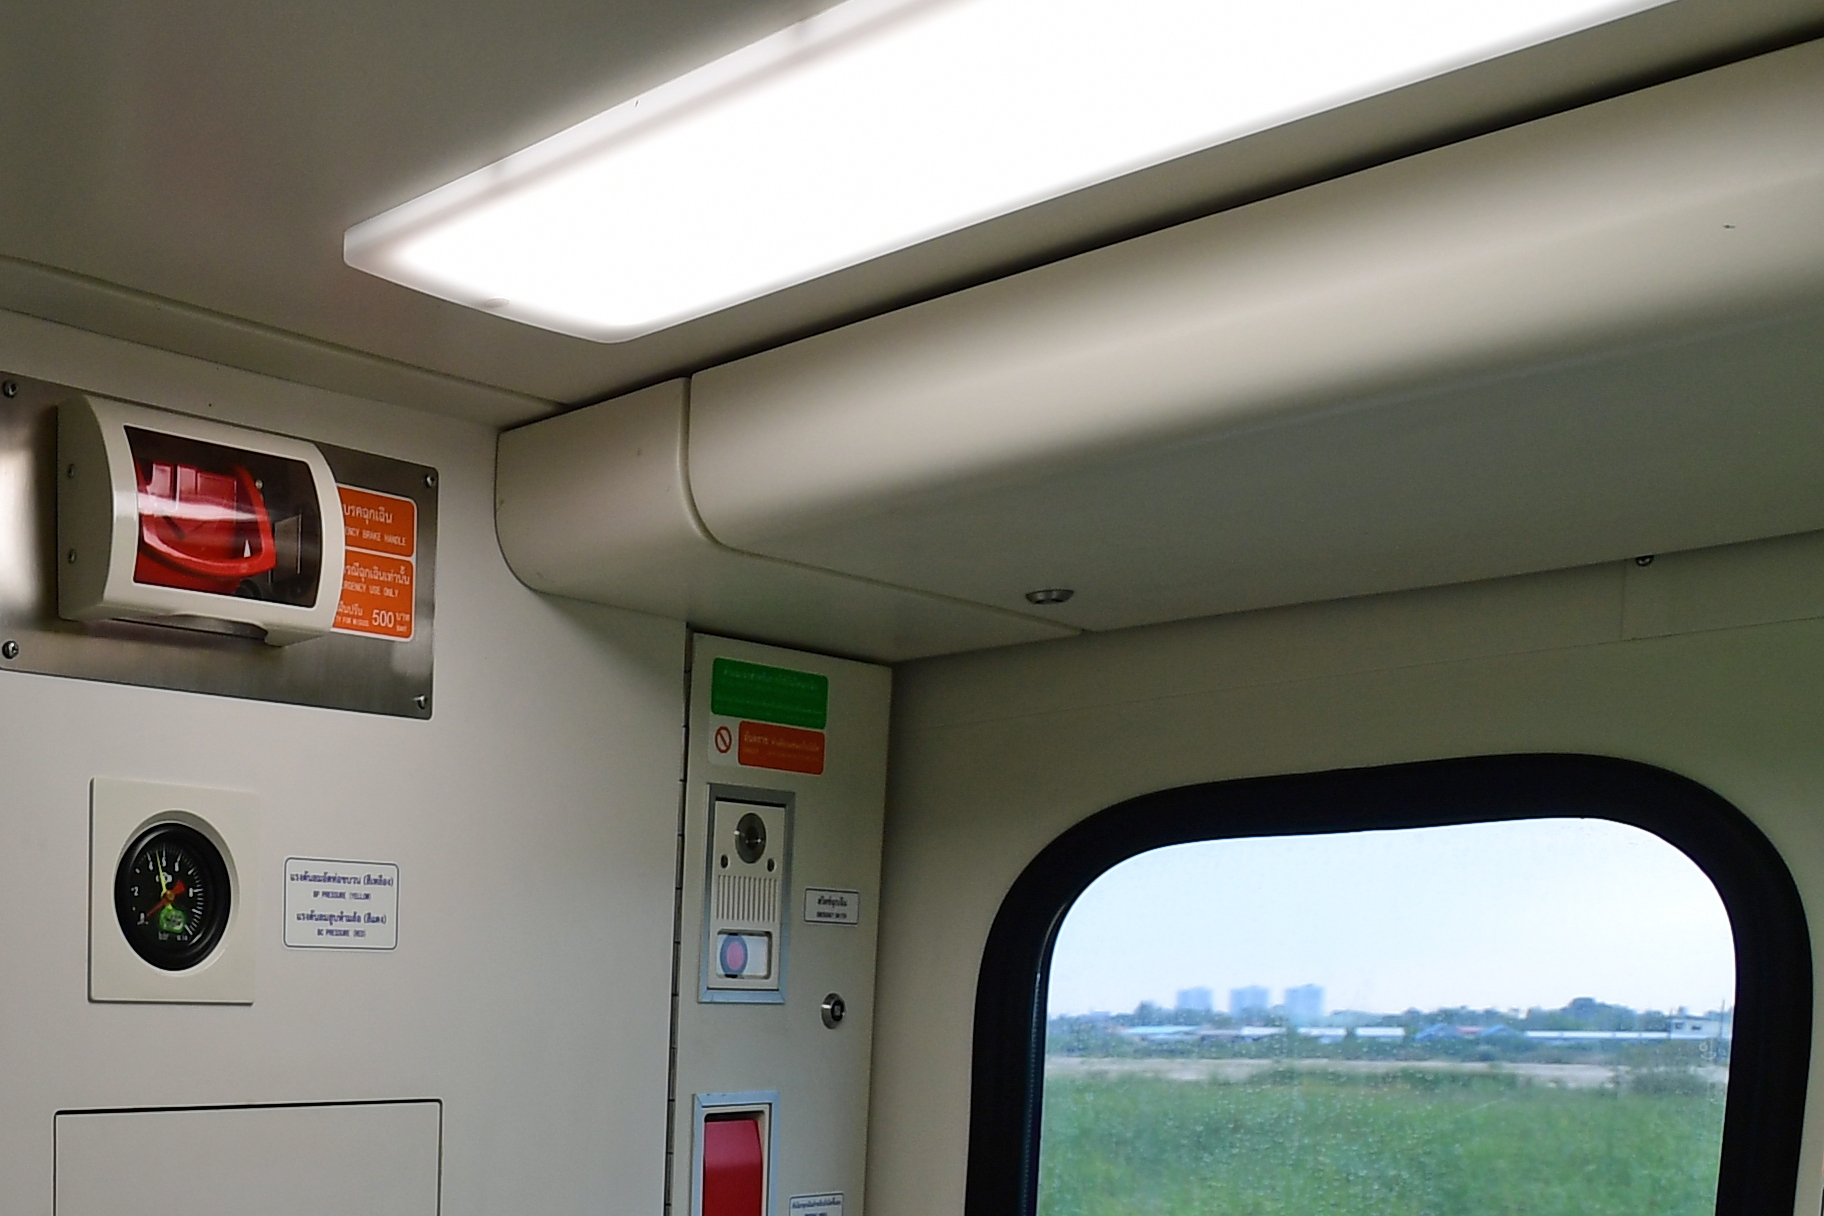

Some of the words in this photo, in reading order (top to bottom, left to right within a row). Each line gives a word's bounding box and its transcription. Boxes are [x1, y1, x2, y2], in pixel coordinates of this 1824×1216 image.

[363, 531, 382, 542] BRAKE
[384, 533, 407, 546] HANDLE
[344, 563, 410, 585] รณีฉุกเฉินเท่านั้น
[343, 581, 367, 593] RGENCY
[372, 609, 394, 628] 500
[321, 891, 346, 899] PRESSURE
[325, 929, 350, 937] PRESSURE
